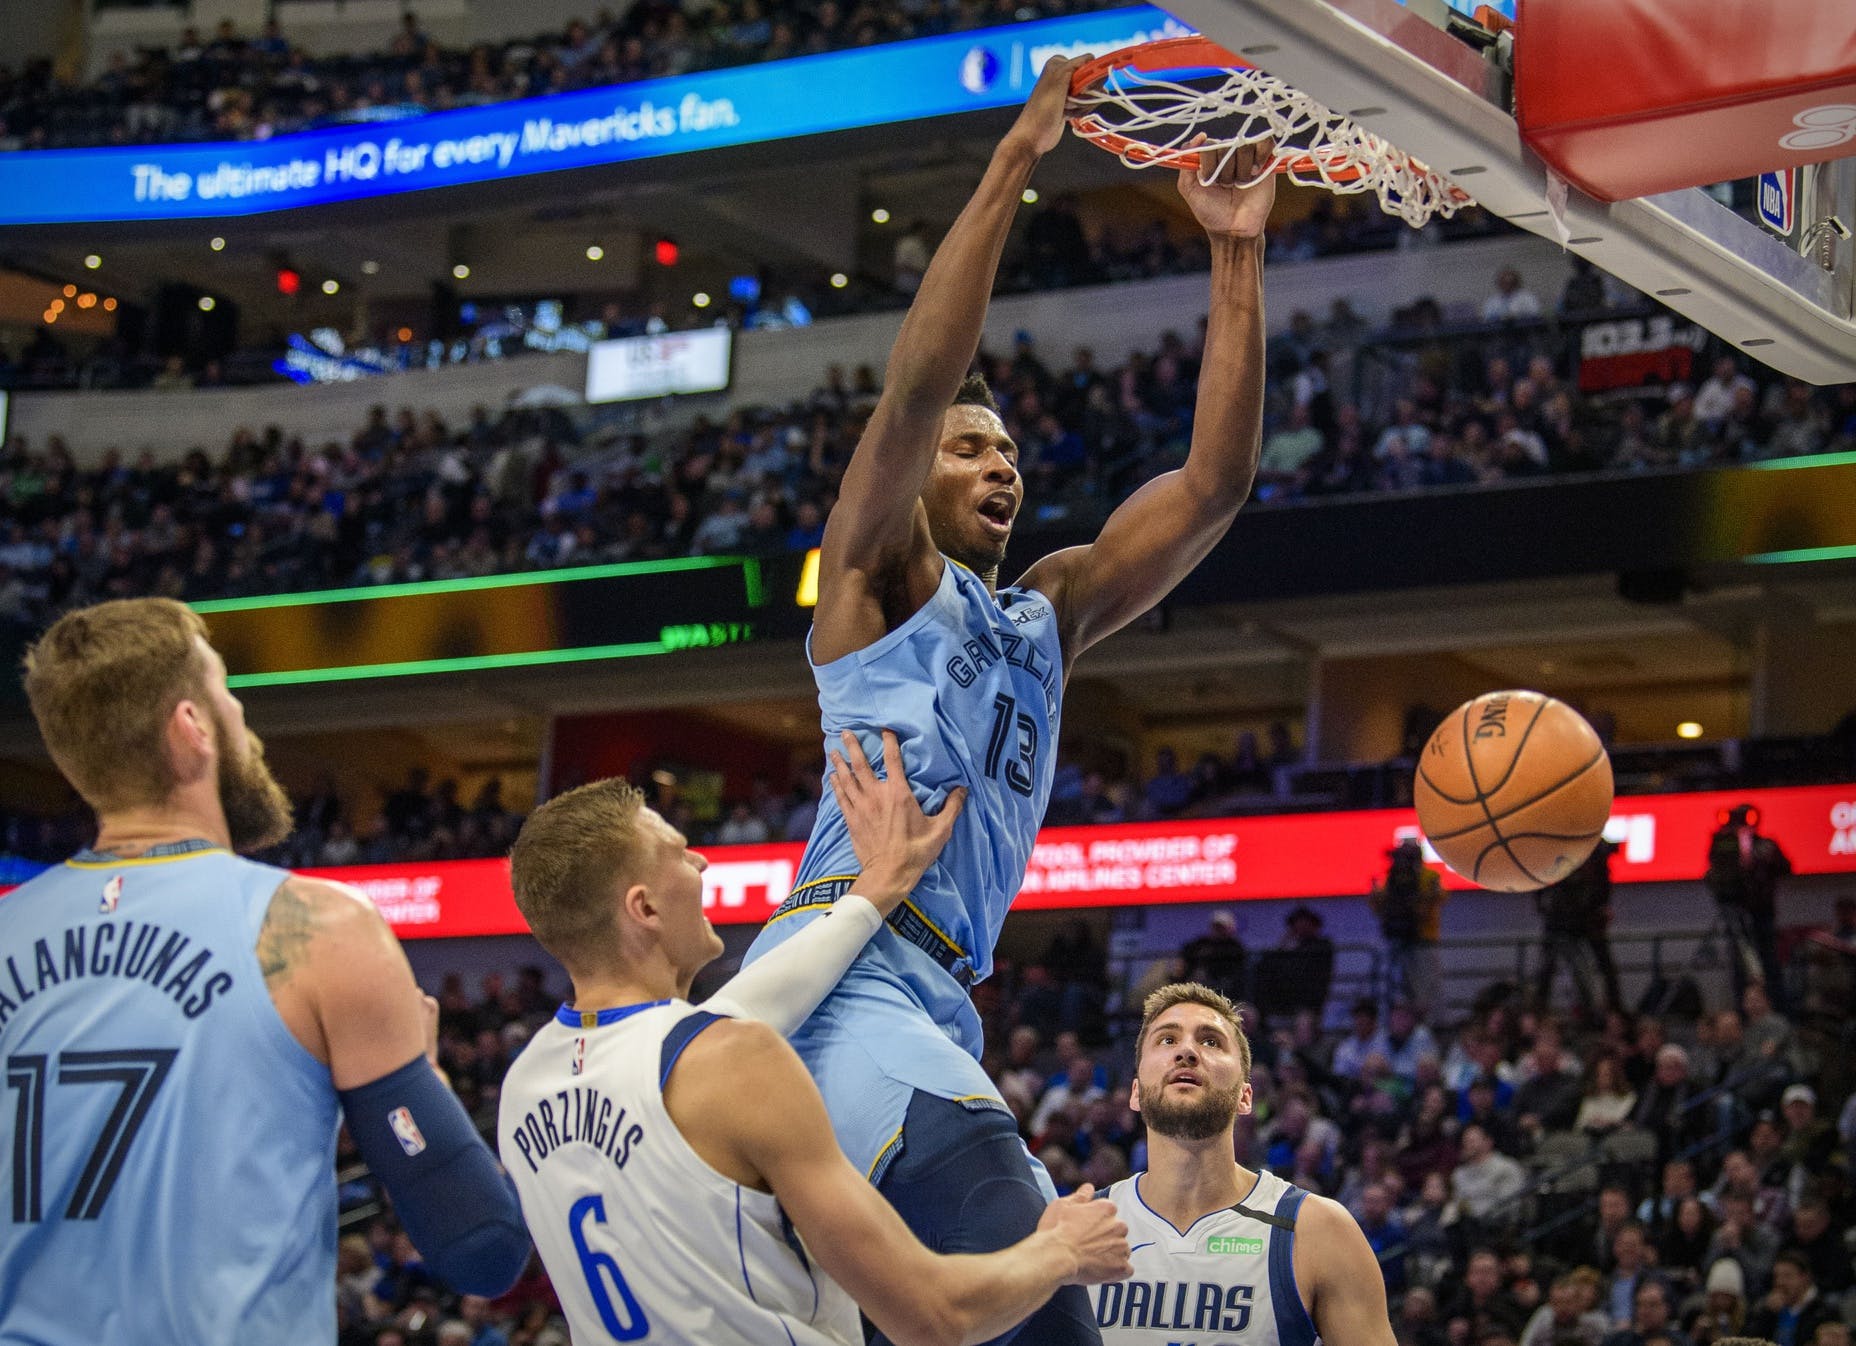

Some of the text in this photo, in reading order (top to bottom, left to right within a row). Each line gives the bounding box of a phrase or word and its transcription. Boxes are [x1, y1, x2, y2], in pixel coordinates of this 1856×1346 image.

[131, 163, 193, 201] The
[197, 159, 322, 199] ultimate
[324, 141, 382, 184] HQ
[384, 138, 430, 175] for
[432, 132, 520, 169] every
[521, 102, 677, 154] Mavericks
[1763, 182, 1780, 219] NBA
[1012, 606, 1049, 627] edEx
[984, 691, 1038, 798] 13
[1046, 863, 1142, 891] AIRLINES
[1144, 858, 1237, 888] CENTER
[1089, 835, 1200, 863] PROVIDER
[1202, 833, 1238, 861] OF
[0, 921, 233, 1025] ALANCIUNAS
[7, 1048, 181, 1224] 17
[513, 1087, 644, 1174] PORZINGIS
[569, 1193, 649, 1342] 6
[1209, 1237, 1262, 1254] chime
[1096, 1280, 1256, 1333] DALLAS
